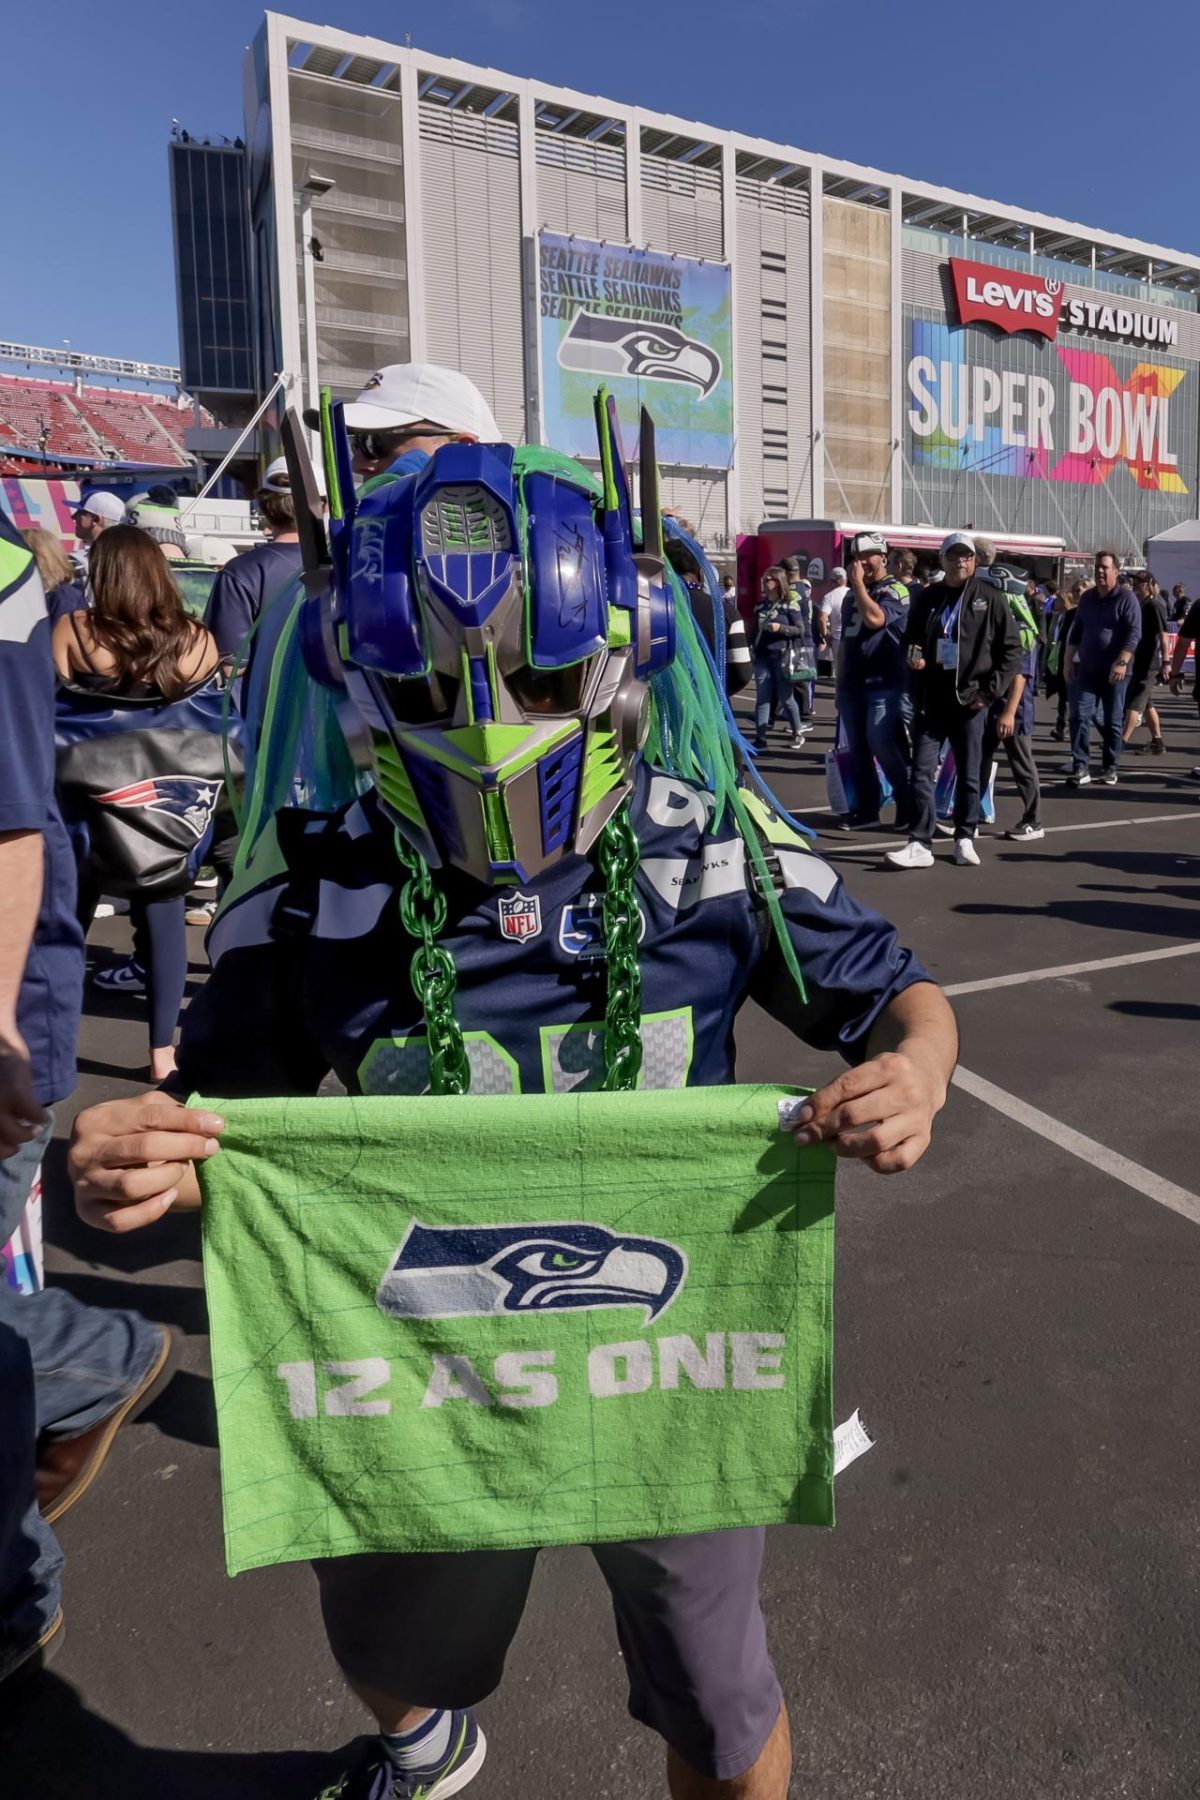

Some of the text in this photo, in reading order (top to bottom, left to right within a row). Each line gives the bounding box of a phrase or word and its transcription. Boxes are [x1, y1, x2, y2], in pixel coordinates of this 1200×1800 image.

[540, 245, 682, 290] SEATTLE SEAHAWKS
[540, 269, 682, 314] SEATTLE SEAHAWKS
[1069, 300, 1178, 346] STADIUM
[907, 355, 1178, 465] SUPER BOWL
[670, 859, 730, 887] SEAWKS
[505, 914, 536, 938] NFL
[276, 1332, 786, 1420] 12 AS ONE
